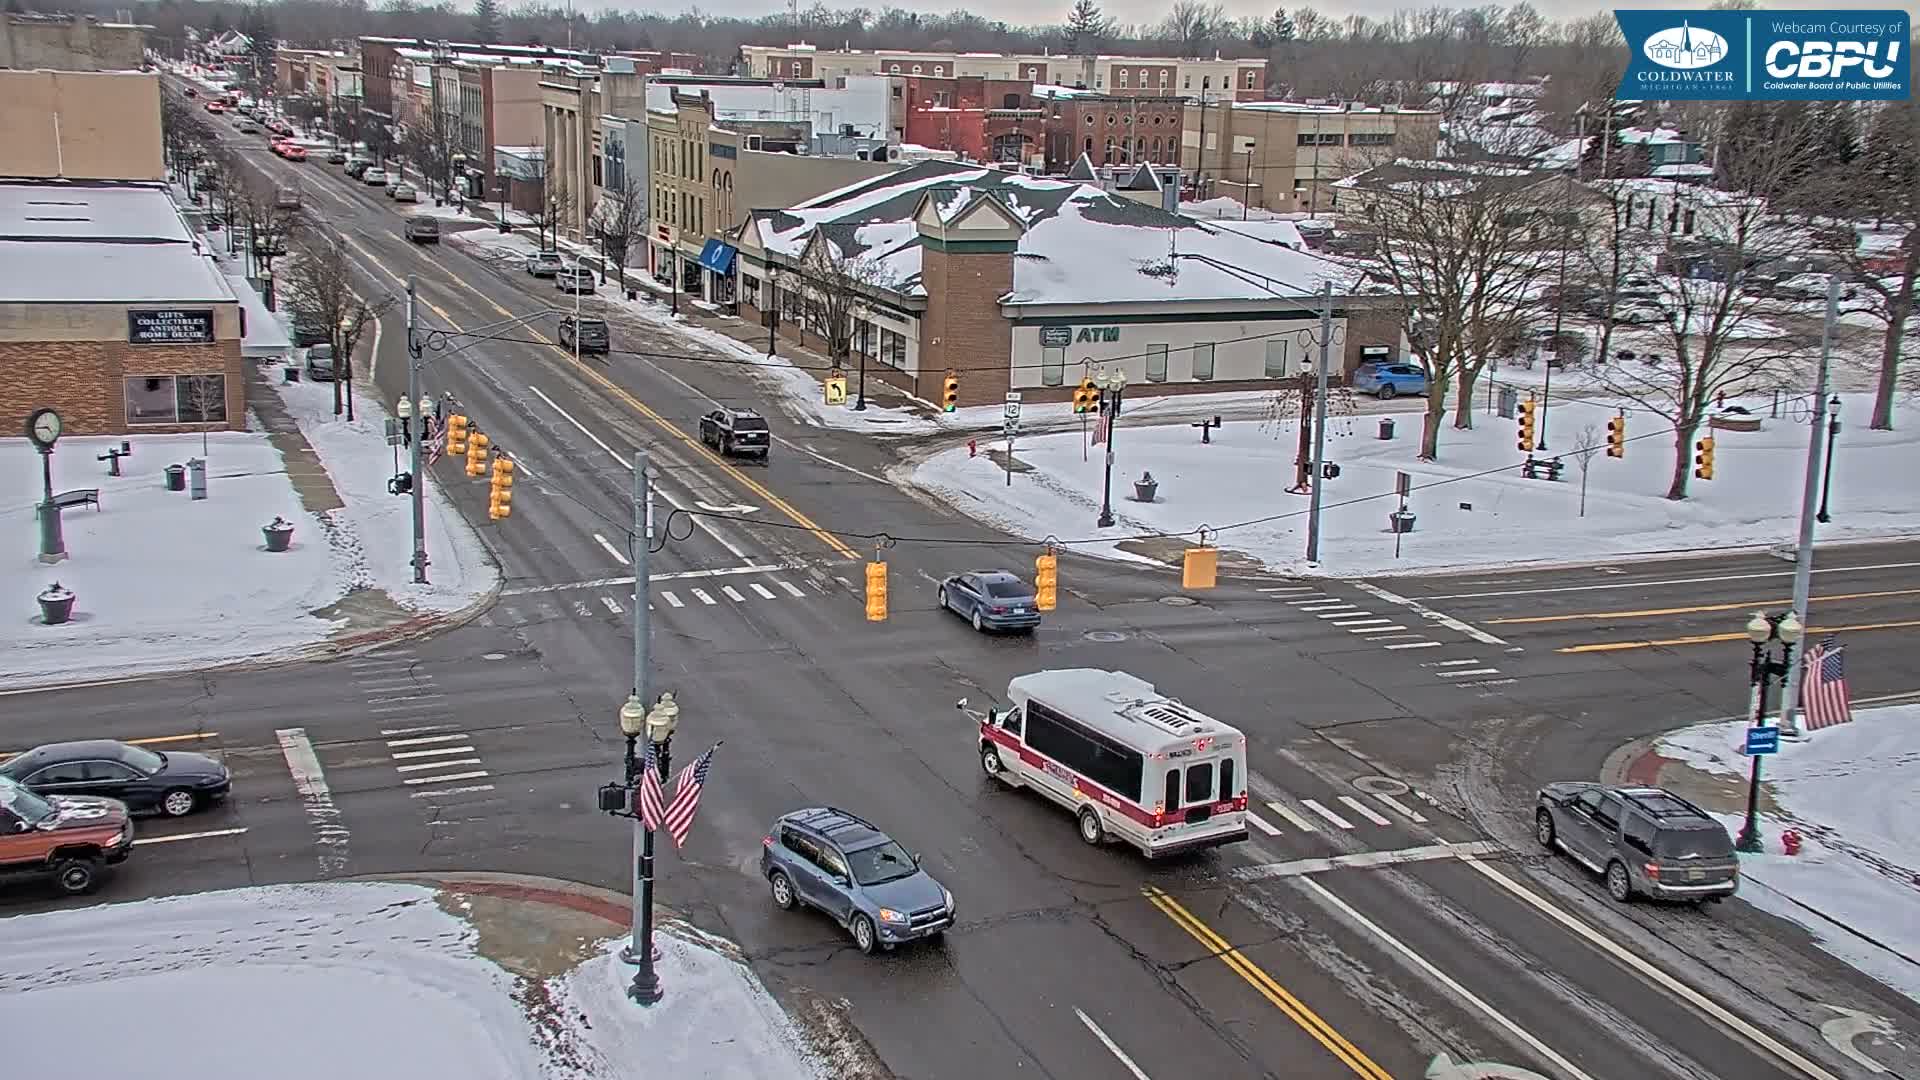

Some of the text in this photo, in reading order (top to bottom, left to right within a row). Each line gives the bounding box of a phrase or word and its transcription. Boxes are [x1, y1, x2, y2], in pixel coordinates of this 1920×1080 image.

[140, 331, 168, 339] HOME
[1075, 326, 1120, 343] ATM
[1008, 404, 1017, 415] 12
